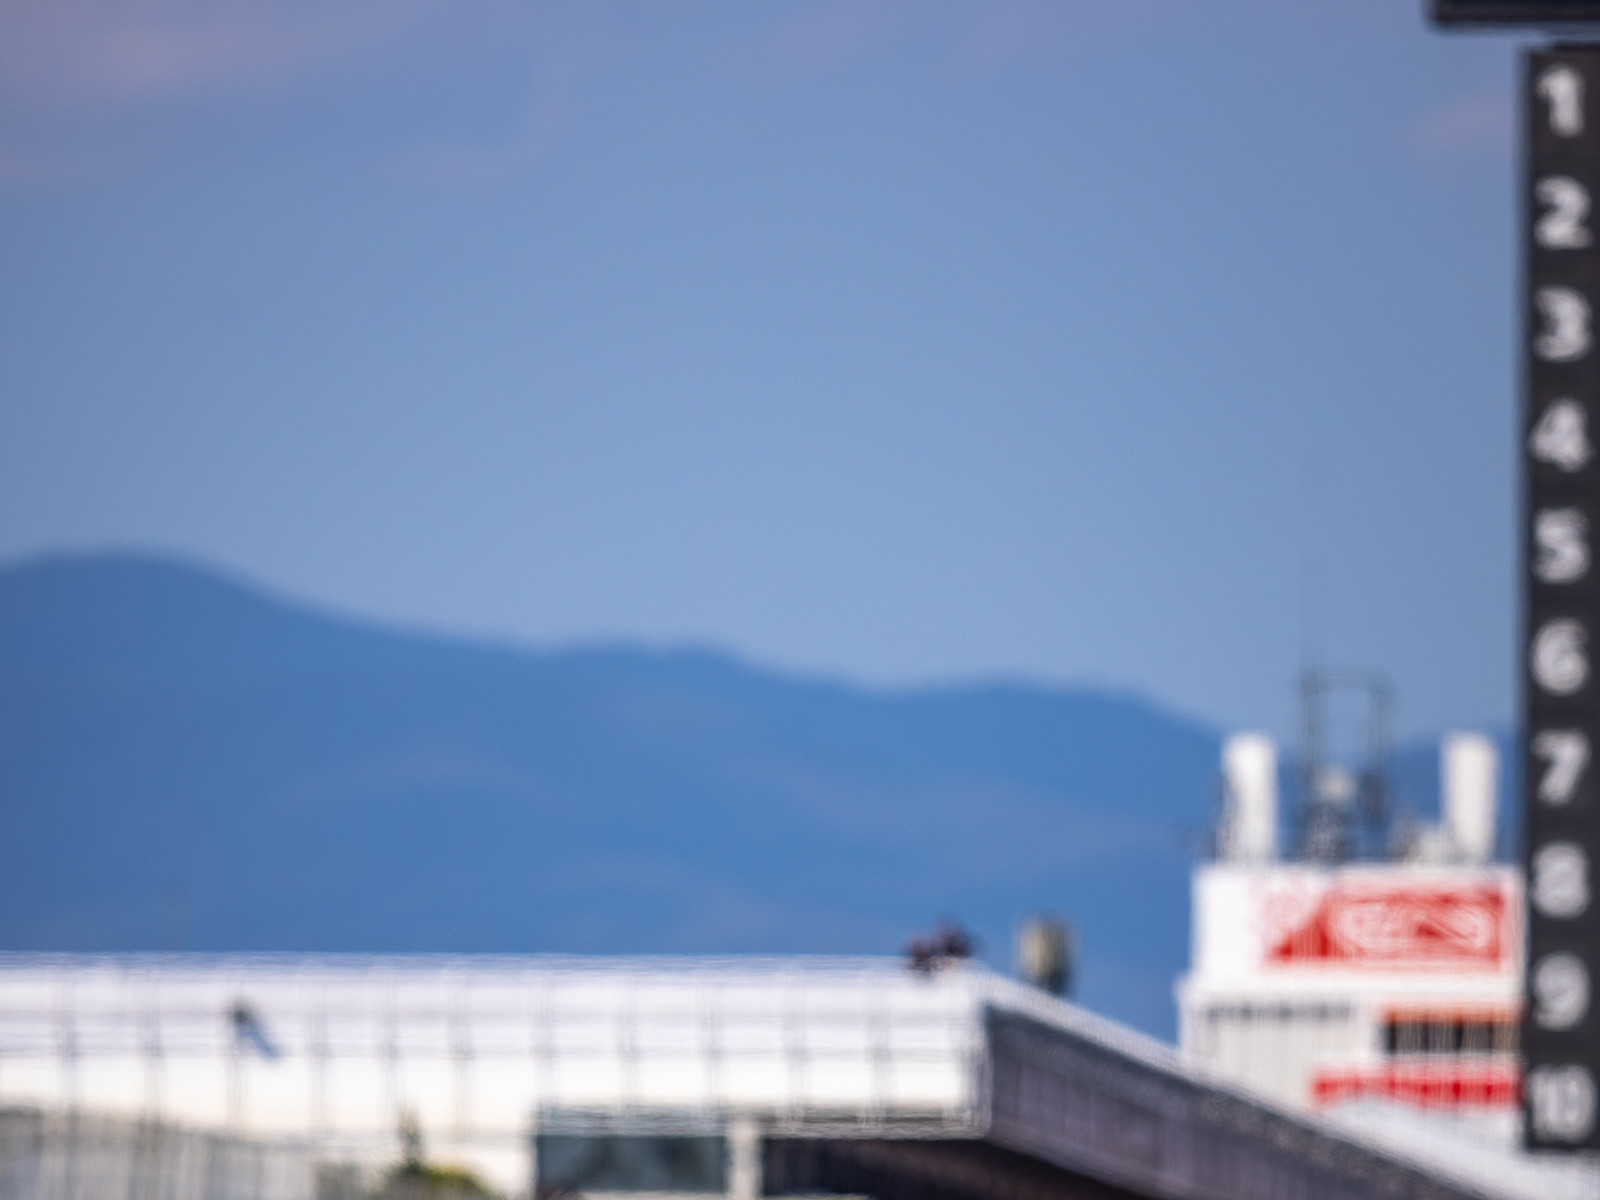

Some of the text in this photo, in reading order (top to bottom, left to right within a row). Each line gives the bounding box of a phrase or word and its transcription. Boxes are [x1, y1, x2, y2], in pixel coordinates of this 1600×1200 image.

[1534, 65, 1584, 136] 1
[1534, 176, 1591, 249] 2
[1534, 286, 1591, 362] 3
[1529, 400, 1591, 471] 4
[1533, 508, 1590, 584] 5
[1530, 618, 1590, 694] 6
[1532, 729, 1591, 805] 7
[1531, 841, 1590, 918] 8
[1532, 952, 1591, 1030] 9
[1527, 1064, 1596, 1142] 10
